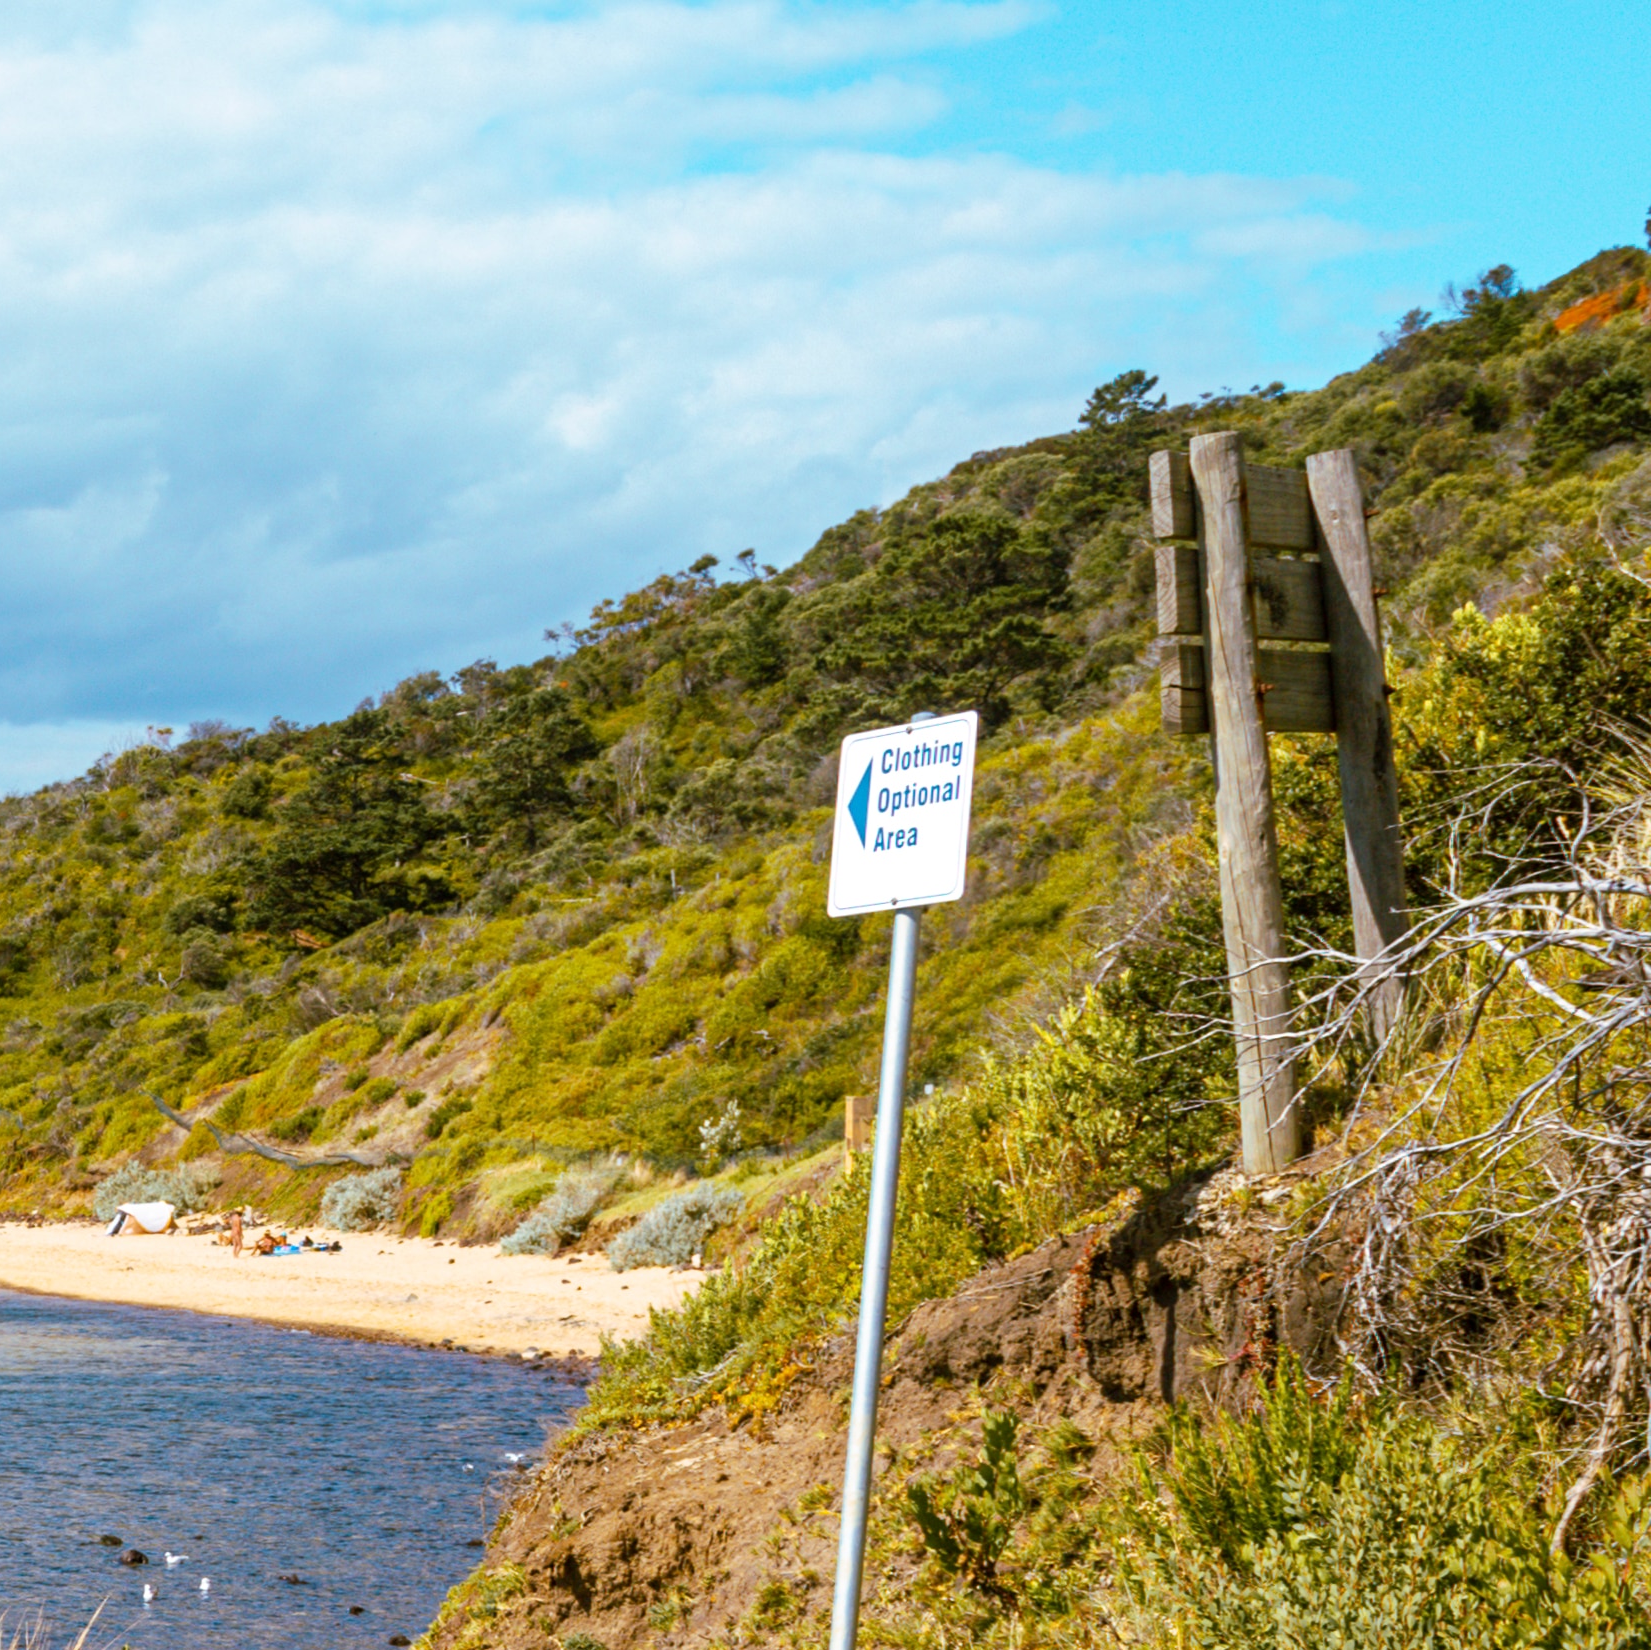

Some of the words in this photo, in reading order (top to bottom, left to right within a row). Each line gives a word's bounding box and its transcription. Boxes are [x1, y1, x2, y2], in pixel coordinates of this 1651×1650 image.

[880, 740, 963, 774] Clothing
[877, 775, 960, 816] Optional
[873, 827, 918, 852] Area
